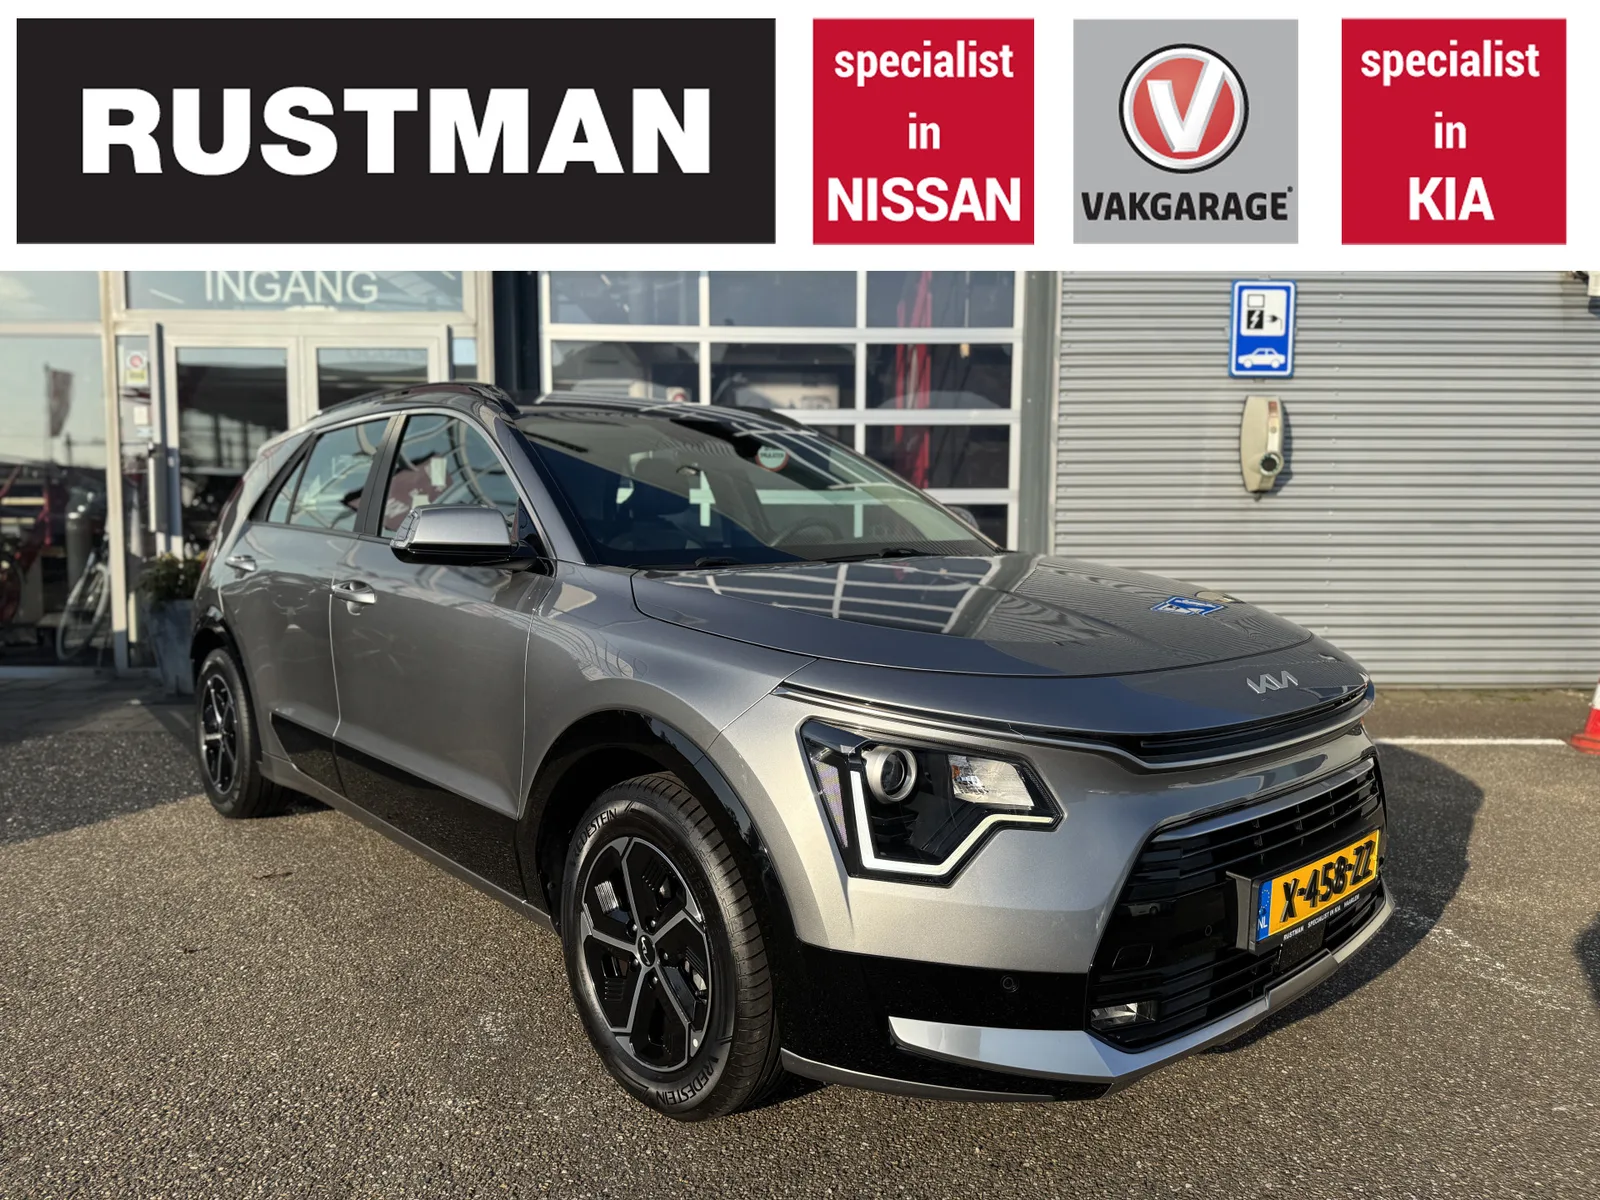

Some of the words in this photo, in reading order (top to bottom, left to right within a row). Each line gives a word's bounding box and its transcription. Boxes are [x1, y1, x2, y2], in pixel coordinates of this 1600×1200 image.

[205, 271, 379, 304] INGANG
[1280, 840, 1375, 923] X-458-ZZ
[1257, 916, 1268, 930] NL
[1283, 925, 1304, 941] RUSTMAN
[1307, 911, 1330, 929] SPECIALIST
[655, 1055, 720, 1106] VREDESTEIN
